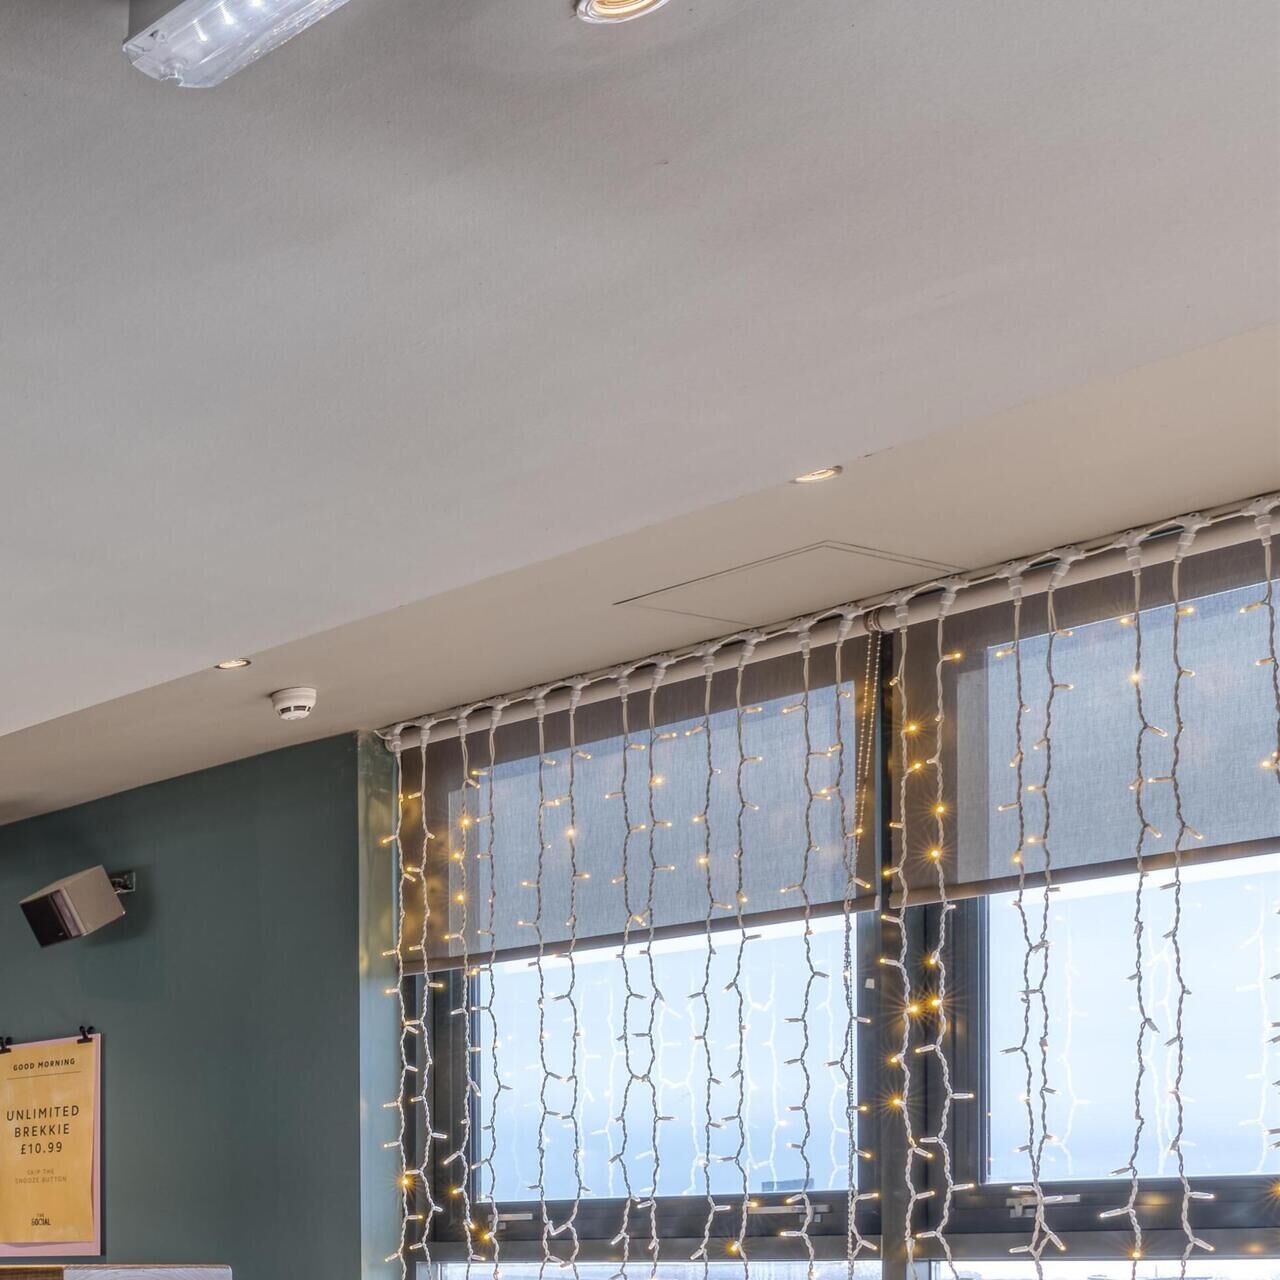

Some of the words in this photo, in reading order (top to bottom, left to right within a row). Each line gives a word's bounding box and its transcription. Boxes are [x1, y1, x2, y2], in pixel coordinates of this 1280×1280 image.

[13, 1062, 35, 1072] GOOD
[38, 1058, 76, 1069] MORNING
[6, 1105, 80, 1122] UNLIMITED
[14, 1123, 70, 1138] BREKKIE
[20, 1142, 63, 1155] £10.99
